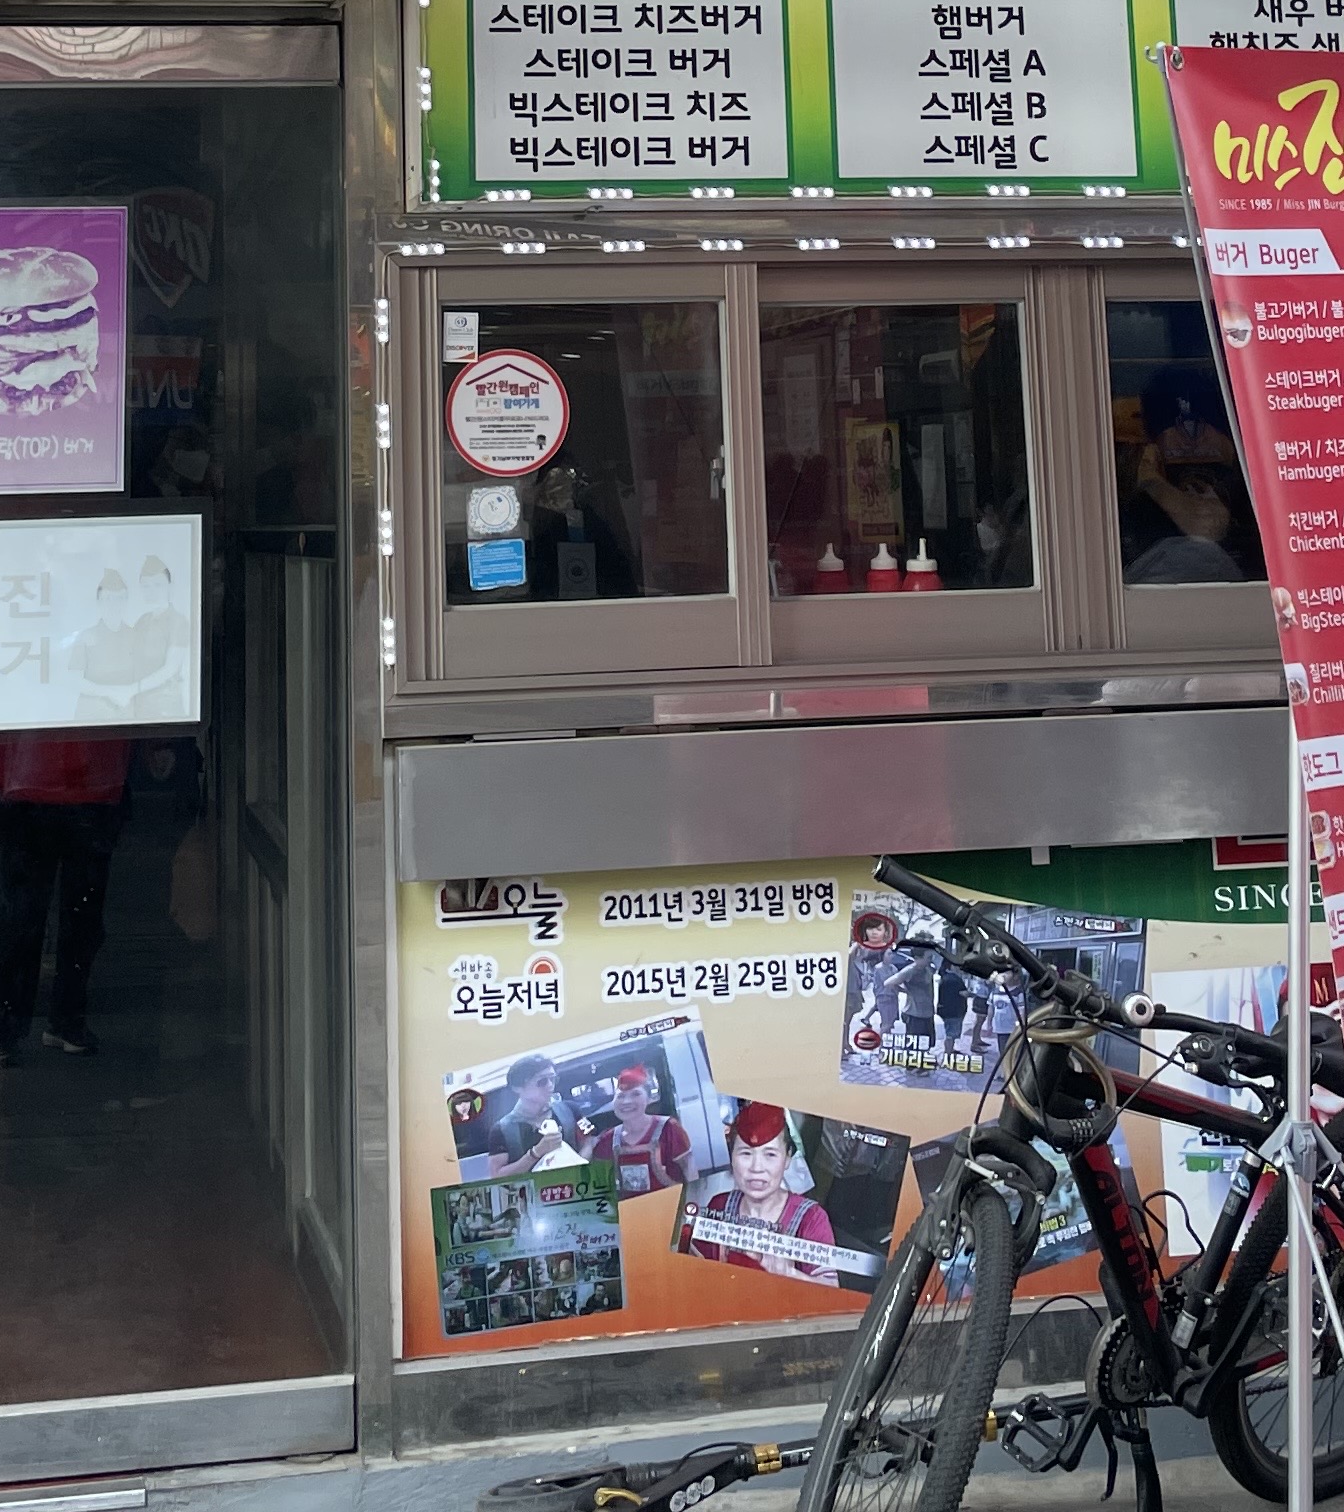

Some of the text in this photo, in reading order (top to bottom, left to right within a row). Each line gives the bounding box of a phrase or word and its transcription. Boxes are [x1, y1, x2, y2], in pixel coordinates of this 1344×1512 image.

[489, 4, 763, 36] 스테이크 치즈버거
[933, 5, 1024, 39] 햄버거
[1255, 0, 1314, 23] 새우
[524, 48, 731, 80] 스테이크 버거
[919, 48, 1046, 81] 스페셜 A
[510, 91, 751, 125] 빅스테이크 치즈
[921, 91, 1046, 124] 스페셜 B
[511, 135, 750, 168] 빅스테이크 버거
[923, 134, 1049, 167] 스페셜 C
[1250, 199, 1272, 211] 1985
[1260, 244, 1319, 269] Buger
[1255, 301, 1319, 320] 불고기버거
[1265, 369, 1341, 388] 스테이크버거
[1268, 394, 1343, 412] Steakbuger
[1289, 510, 1338, 531] 치킨버거
[604, 890, 683, 922] 2011년
[693, 888, 727, 920] 3월
[735, 885, 784, 916] 31일
[793, 883, 835, 915] 방영
[454, 957, 838, 1019] 오늘저녁 2015년 2월 25일 방영
[446, 1251, 475, 1266] KBS
